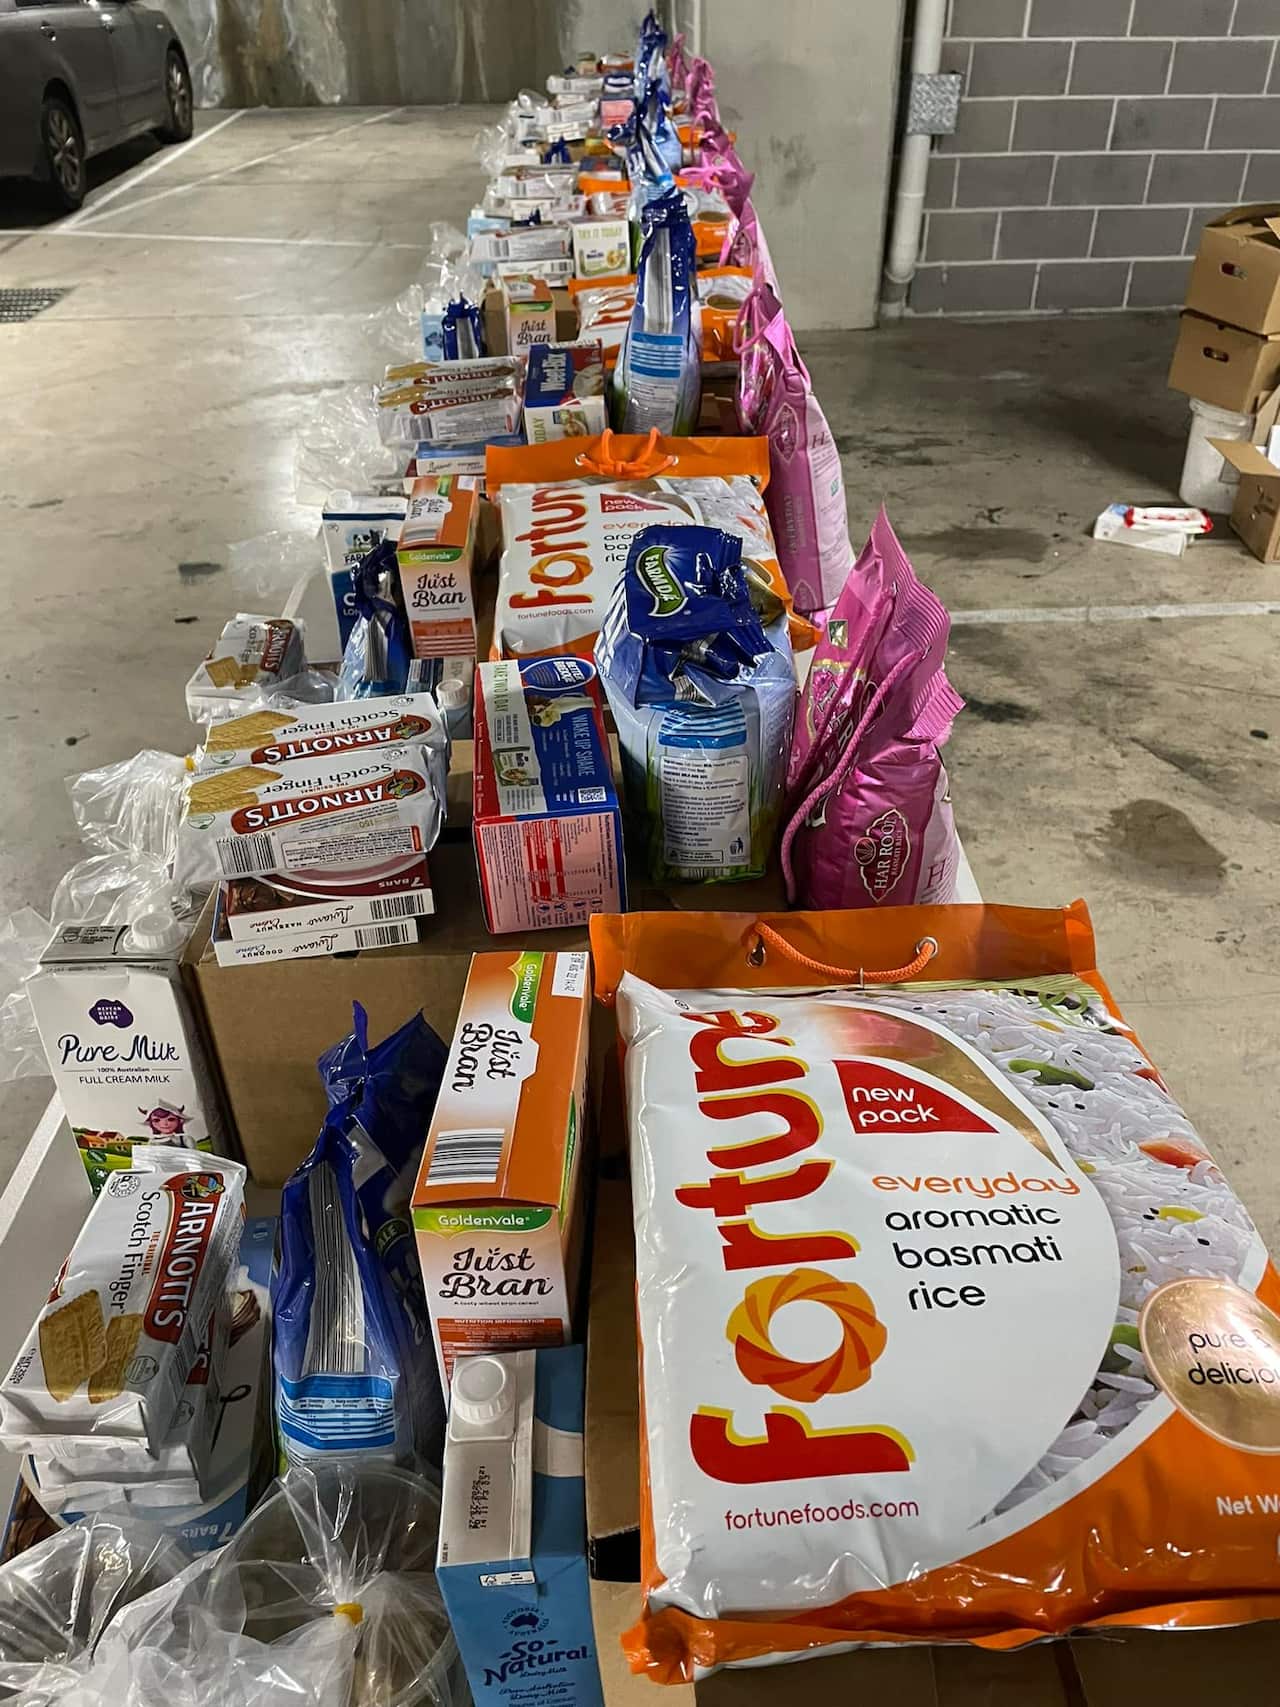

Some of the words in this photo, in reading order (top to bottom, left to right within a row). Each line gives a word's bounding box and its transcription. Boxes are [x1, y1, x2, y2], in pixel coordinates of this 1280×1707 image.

[516, 332, 552, 345] Bran
[411, 589, 467, 608] Bran
[518, 608, 594, 620] fortunefoods.com
[495, 678, 508, 694] TWO
[340, 708, 399, 730] Scotch
[496, 701, 509, 712] DAY
[280, 720, 334, 737] Finger
[571, 713, 588, 738] WAKE
[264, 728, 391, 762] ARNOTT'S
[574, 739, 591, 750] UP
[329, 764, 392, 785] Scotch
[576, 750, 596, 777] SHAKE
[264, 777, 322, 796] Finger
[245, 784, 383, 827] ARNOTT'S
[378, 878, 408, 888] BARS
[411, 876, 424, 888] 7
[874, 860, 891, 889] HAR
[242, 948, 283, 958] COCONUT
[518, 963, 537, 1010] Goldenvale
[57, 1033, 119, 1065] Pure
[120, 1034, 180, 1062] Milk
[451, 1022, 494, 1093] Bran
[79, 1075, 104, 1084] FULL
[105, 1075, 143, 1084] CREAM
[144, 1074, 171, 1084] MILK
[852, 1085, 915, 1104] new
[859, 1103, 940, 1128] pack
[872, 1170, 1081, 1200] everyday
[127, 1190, 162, 1249] Scotch
[438, 1213, 525, 1227] Goldenvale
[884, 1204, 1062, 1231] aromatic
[140, 1241, 159, 1276] ORIGINAL
[675, 1008, 916, 1485] fortune
[892, 1236, 1063, 1270] basmati
[153, 1200, 215, 1328] ARNOTT'S
[109, 1252, 144, 1310] Finger
[438, 1272, 554, 1299] Bran
[908, 1283, 987, 1311] rice
[1188, 1333, 1247, 1354] pure
[725, 1497, 920, 1531] fortunefoods.com
[1215, 1495, 1254, 1516] Net
[483, 1645, 587, 1686] Natural
